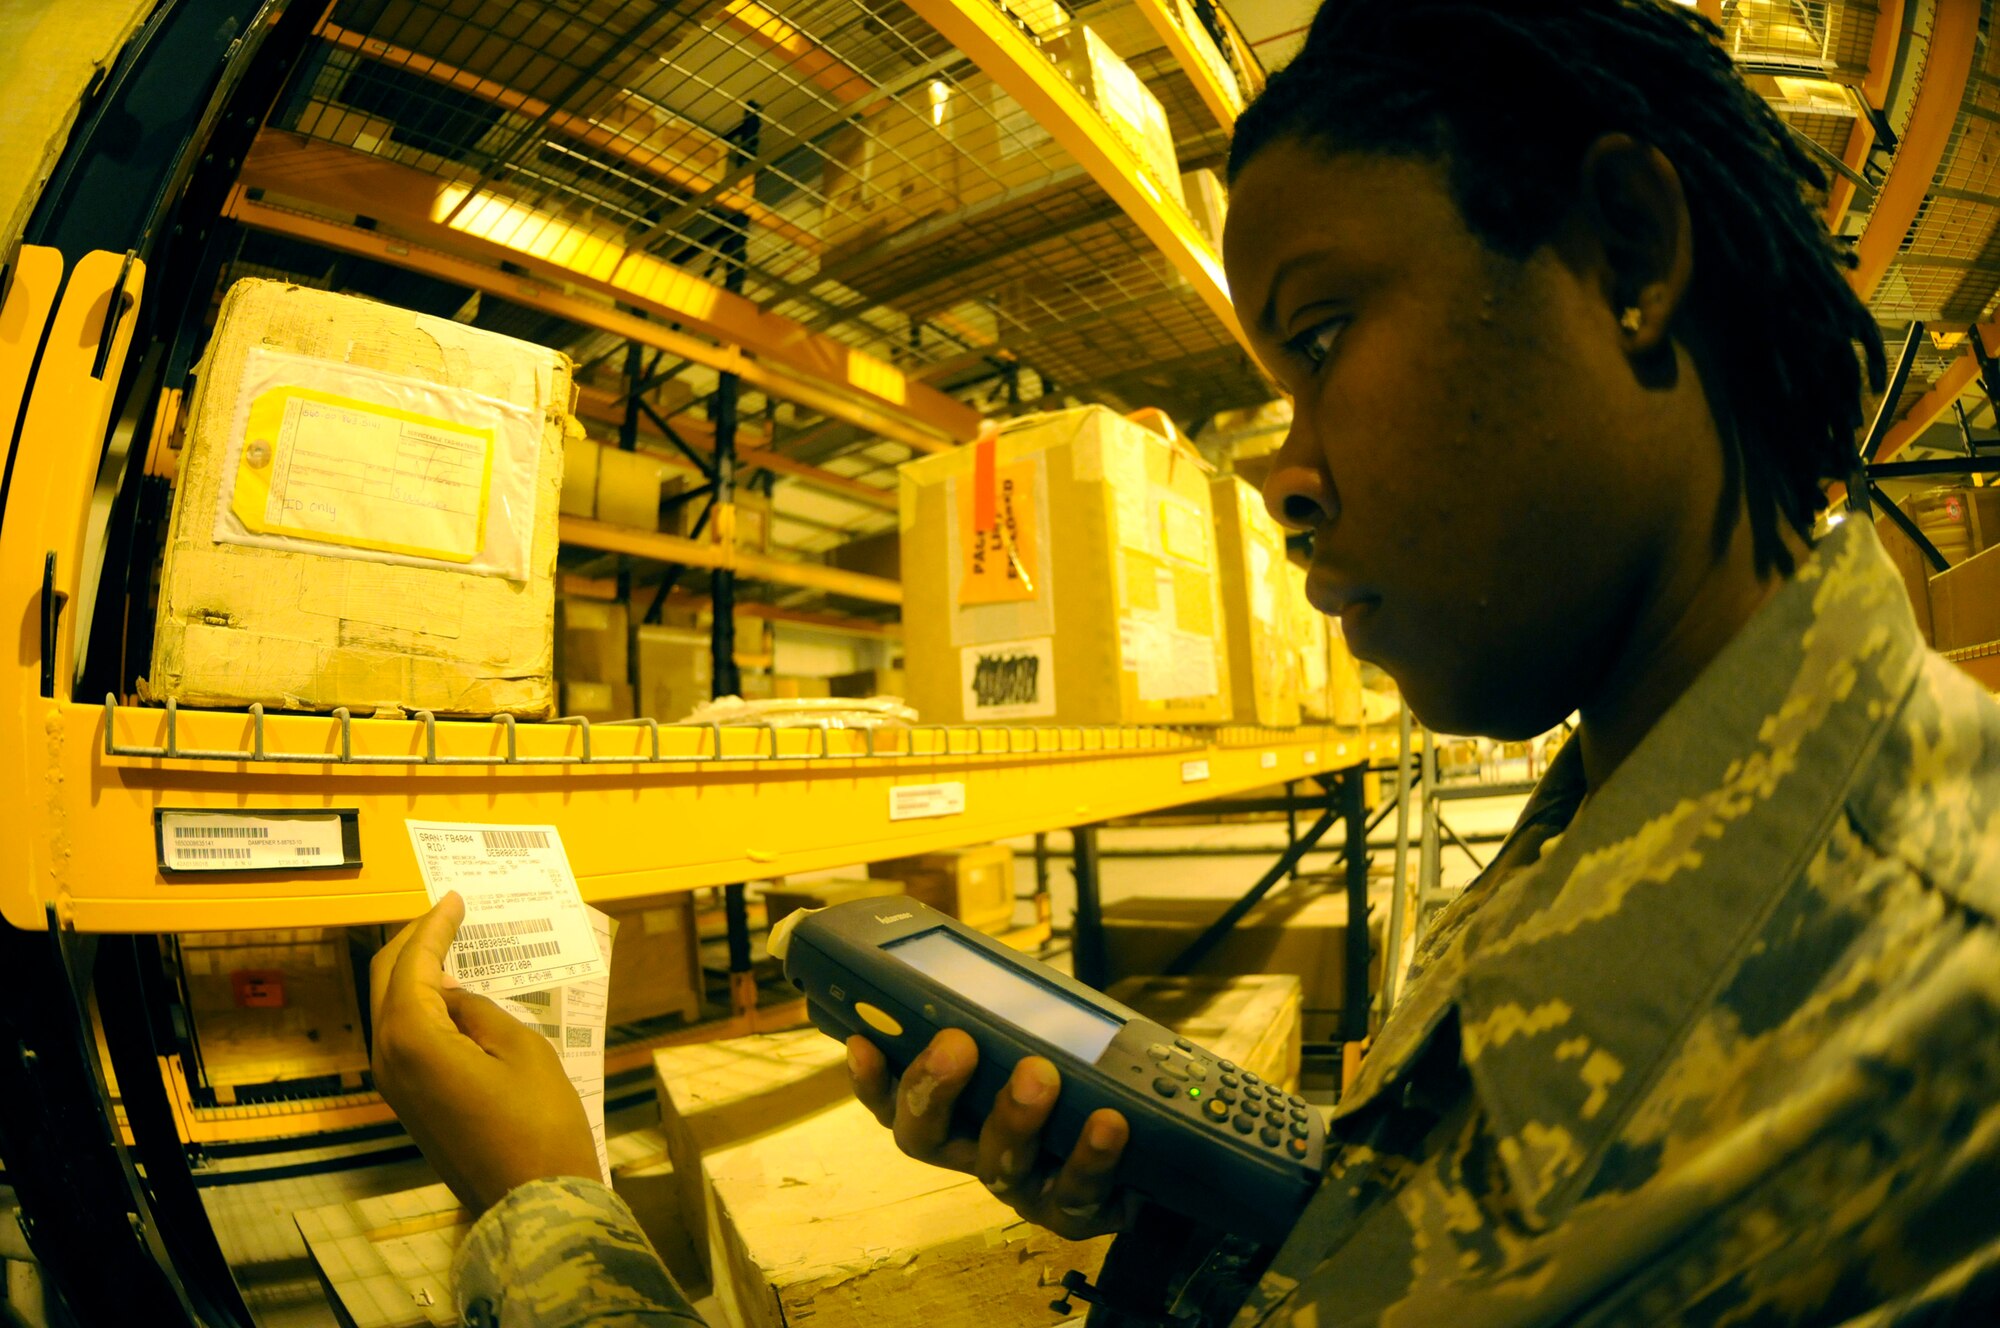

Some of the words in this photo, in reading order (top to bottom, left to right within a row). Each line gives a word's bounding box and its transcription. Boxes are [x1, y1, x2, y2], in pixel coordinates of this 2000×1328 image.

[283, 498, 303, 511] ID
[419, 832, 443, 842] SRAN:
[445, 834, 474, 843] FB4804
[426, 842, 446, 852] RID:
